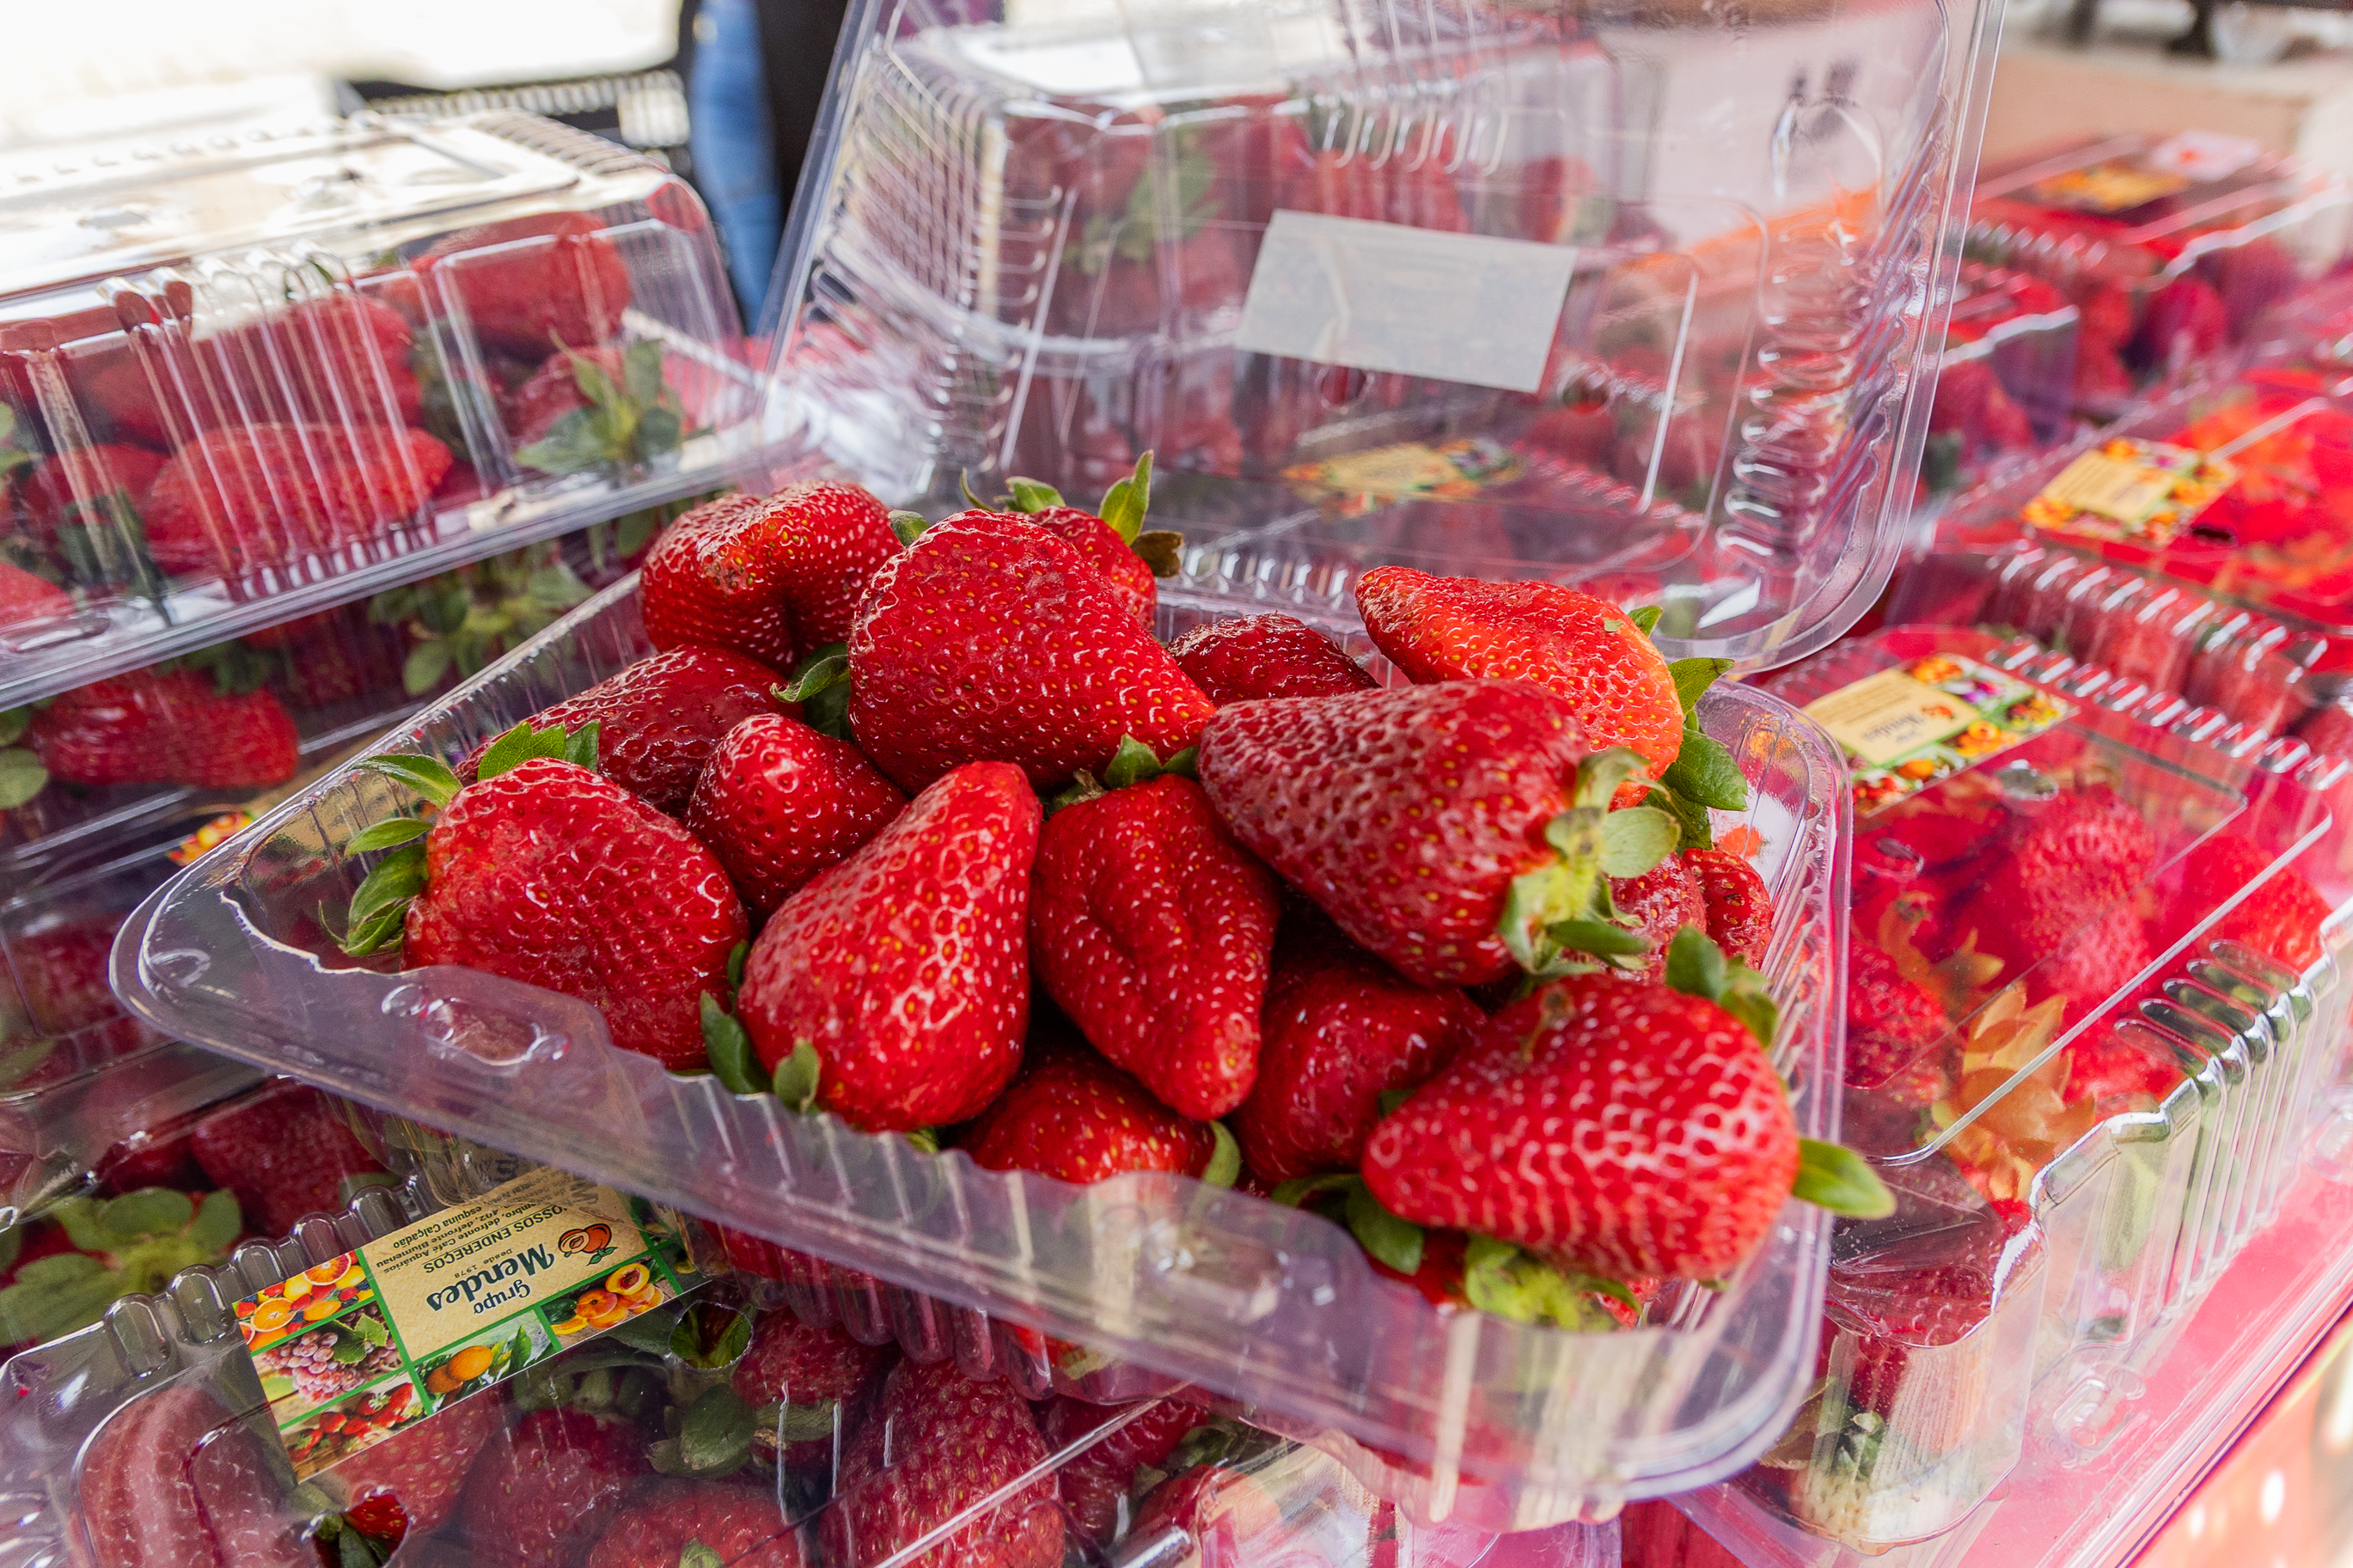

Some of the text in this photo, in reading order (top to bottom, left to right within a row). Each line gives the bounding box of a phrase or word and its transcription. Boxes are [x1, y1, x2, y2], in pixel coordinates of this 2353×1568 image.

[443, 1206, 481, 1227] esquina
[458, 1217, 500, 1240] defronte
[393, 1223, 441, 1248] Calçadão
[431, 1221, 474, 1243] defronte
[376, 1242, 429, 1267] Blumenau
[423, 1228, 511, 1273] ENDEREÇOS
[432, 1238, 455, 1253] Café
[383, 1250, 429, 1275] Aquários
[454, 1248, 513, 1278] Desde 1978
[426, 1243, 554, 1311] Mendes
[474, 1279, 530, 1314] Grupo
